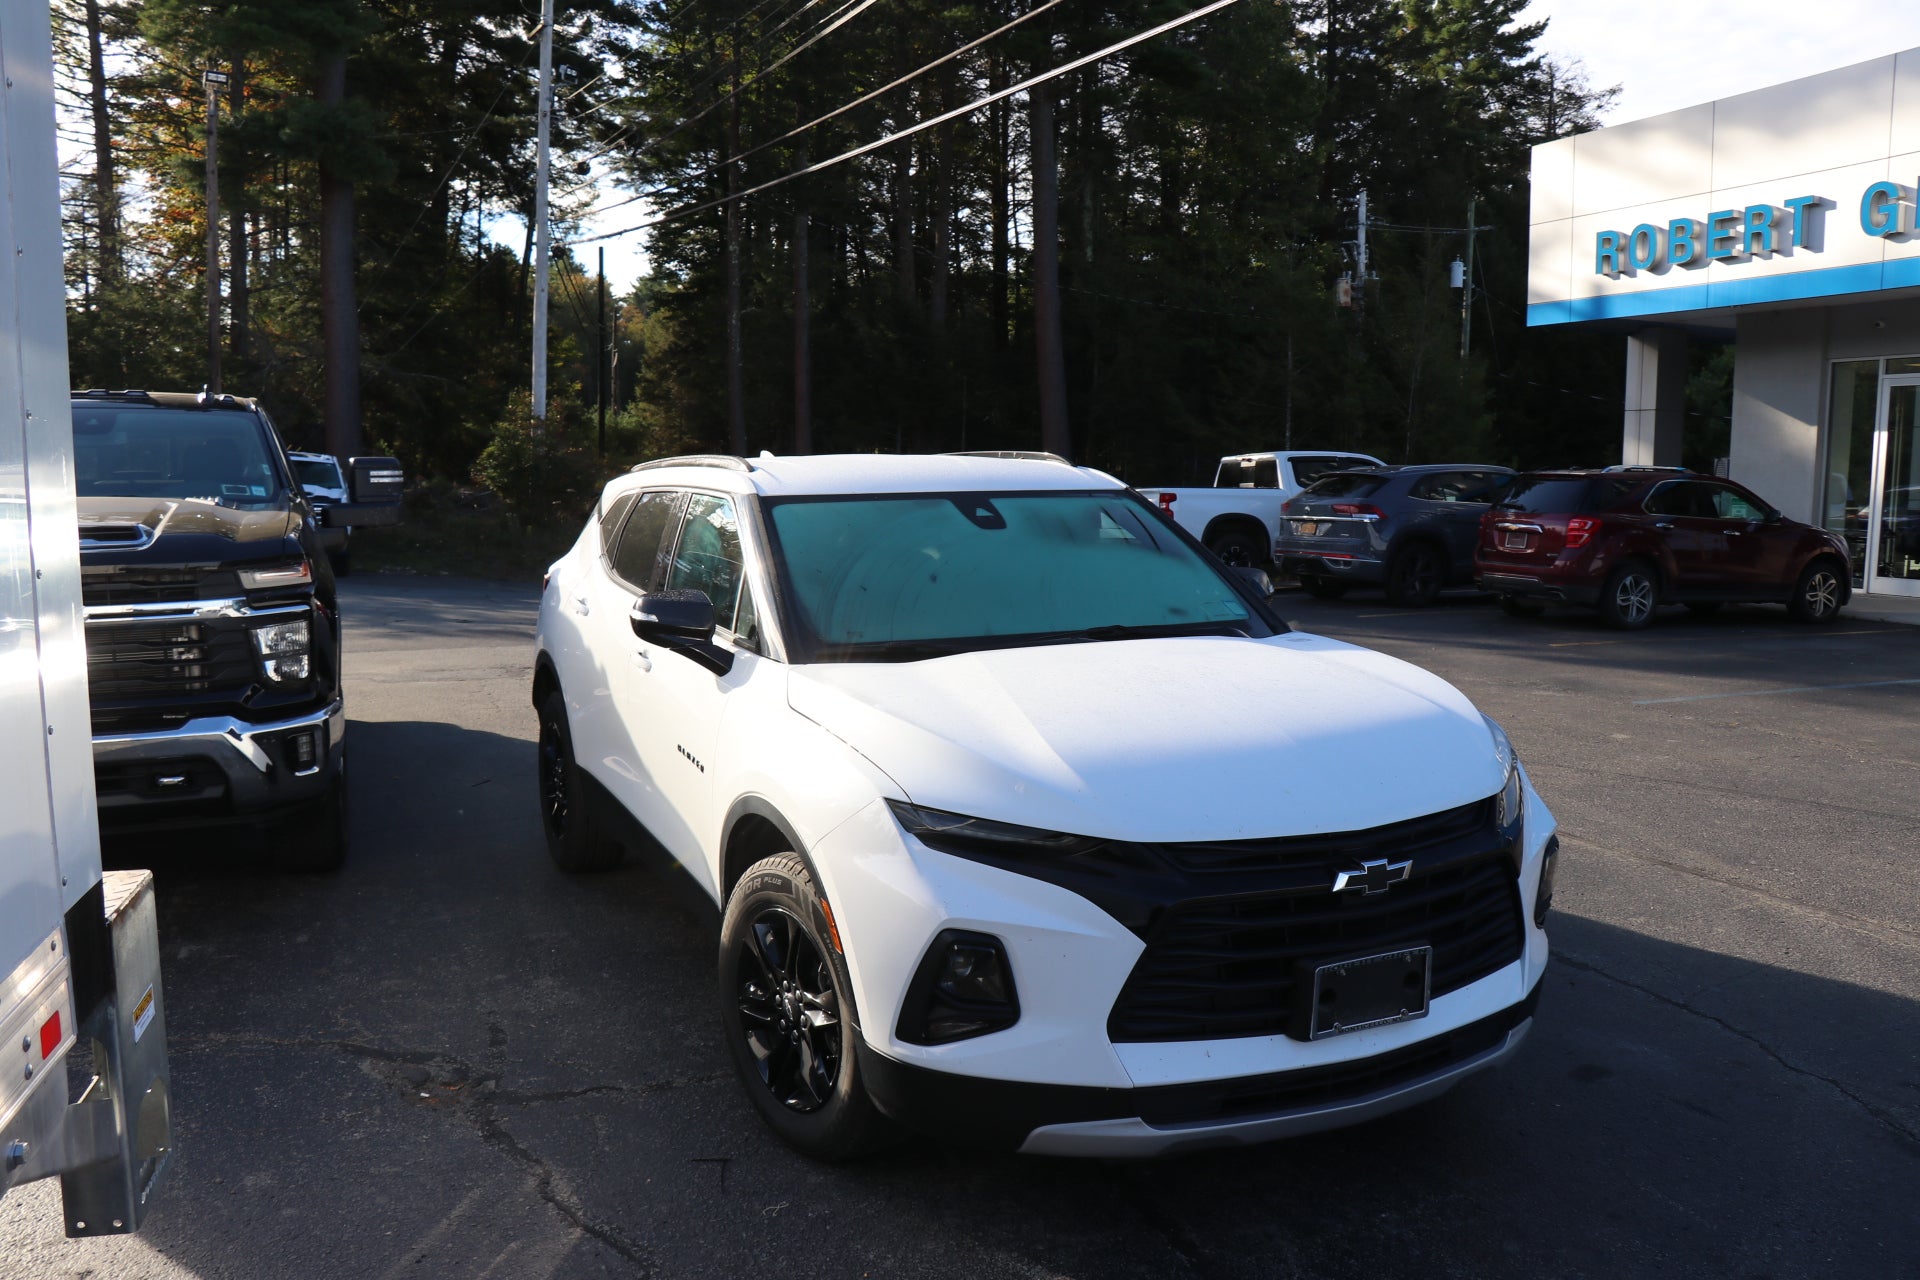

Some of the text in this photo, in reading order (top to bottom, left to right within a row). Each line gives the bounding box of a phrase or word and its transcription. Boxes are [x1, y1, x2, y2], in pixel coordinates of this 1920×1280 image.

[1596, 176, 1920, 274] ROBERT G
[763, 876, 783, 886] PLUS
